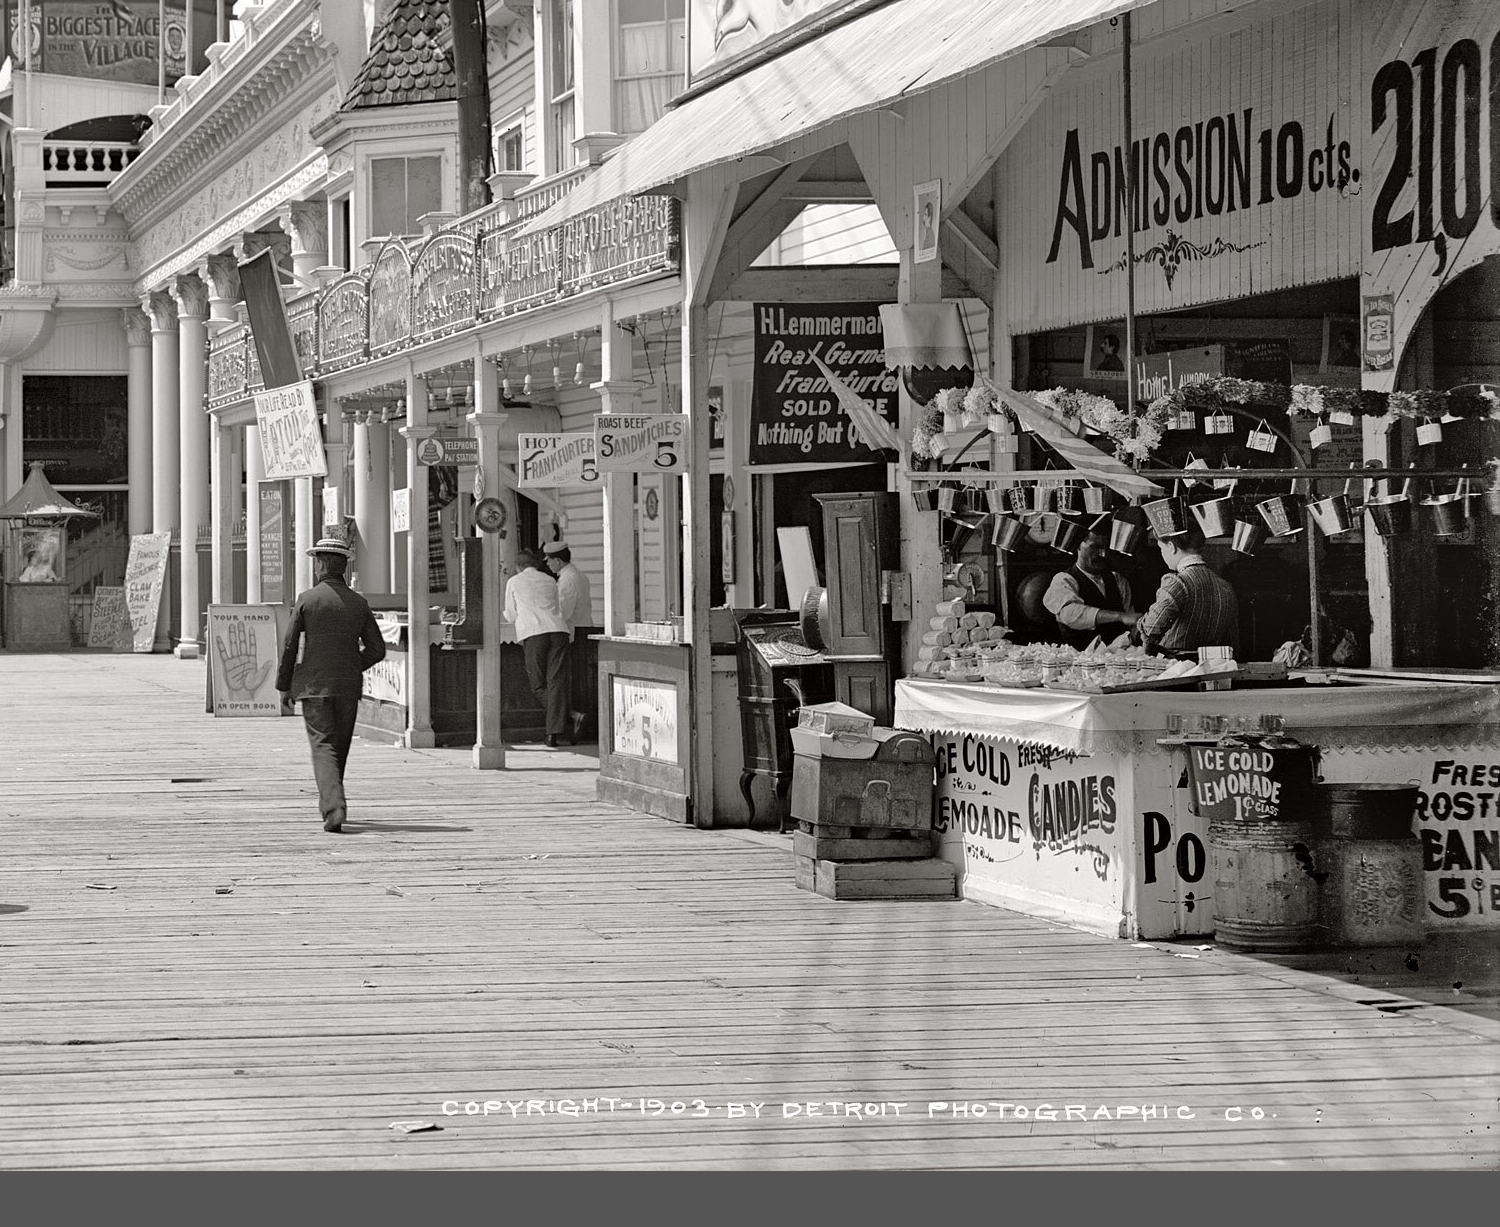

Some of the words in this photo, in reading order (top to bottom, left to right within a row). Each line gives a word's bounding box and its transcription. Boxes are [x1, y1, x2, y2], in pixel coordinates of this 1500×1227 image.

[46, 16, 113, 37] BIGGEST
[117, 16, 160, 37] PLACE
[1046, 107, 1254, 270] ADMISSION
[1257, 120, 1304, 206] 10
[763, 340, 823, 365] Real
[824, 341, 886, 365] Germa
[781, 399, 832, 417] SOLD
[837, 399, 889, 416] HRE
[598, 417, 622, 429] ROAST
[624, 417, 653, 429] BEEF
[444, 441, 477, 450] TELEPHONE
[525, 437, 561, 449] HOT
[601, 421, 682, 459] SANDWICHES
[758, 423, 814, 453] Nothing
[817, 422, 844, 444] But
[456, 454, 478, 462] STATION
[129, 582, 152, 592] CLAM
[128, 593, 150, 603] BAKE
[963, 732, 1011, 787] COLD
[1018, 744, 1052, 770] FRESH
[1197, 749, 1225, 771] ICE
[1229, 751, 1275, 773] COLD
[1196, 772, 1282, 806] LEMONADE
[1028, 772, 1117, 845] CANDIES
[1255, 800, 1280, 817] GLASS
